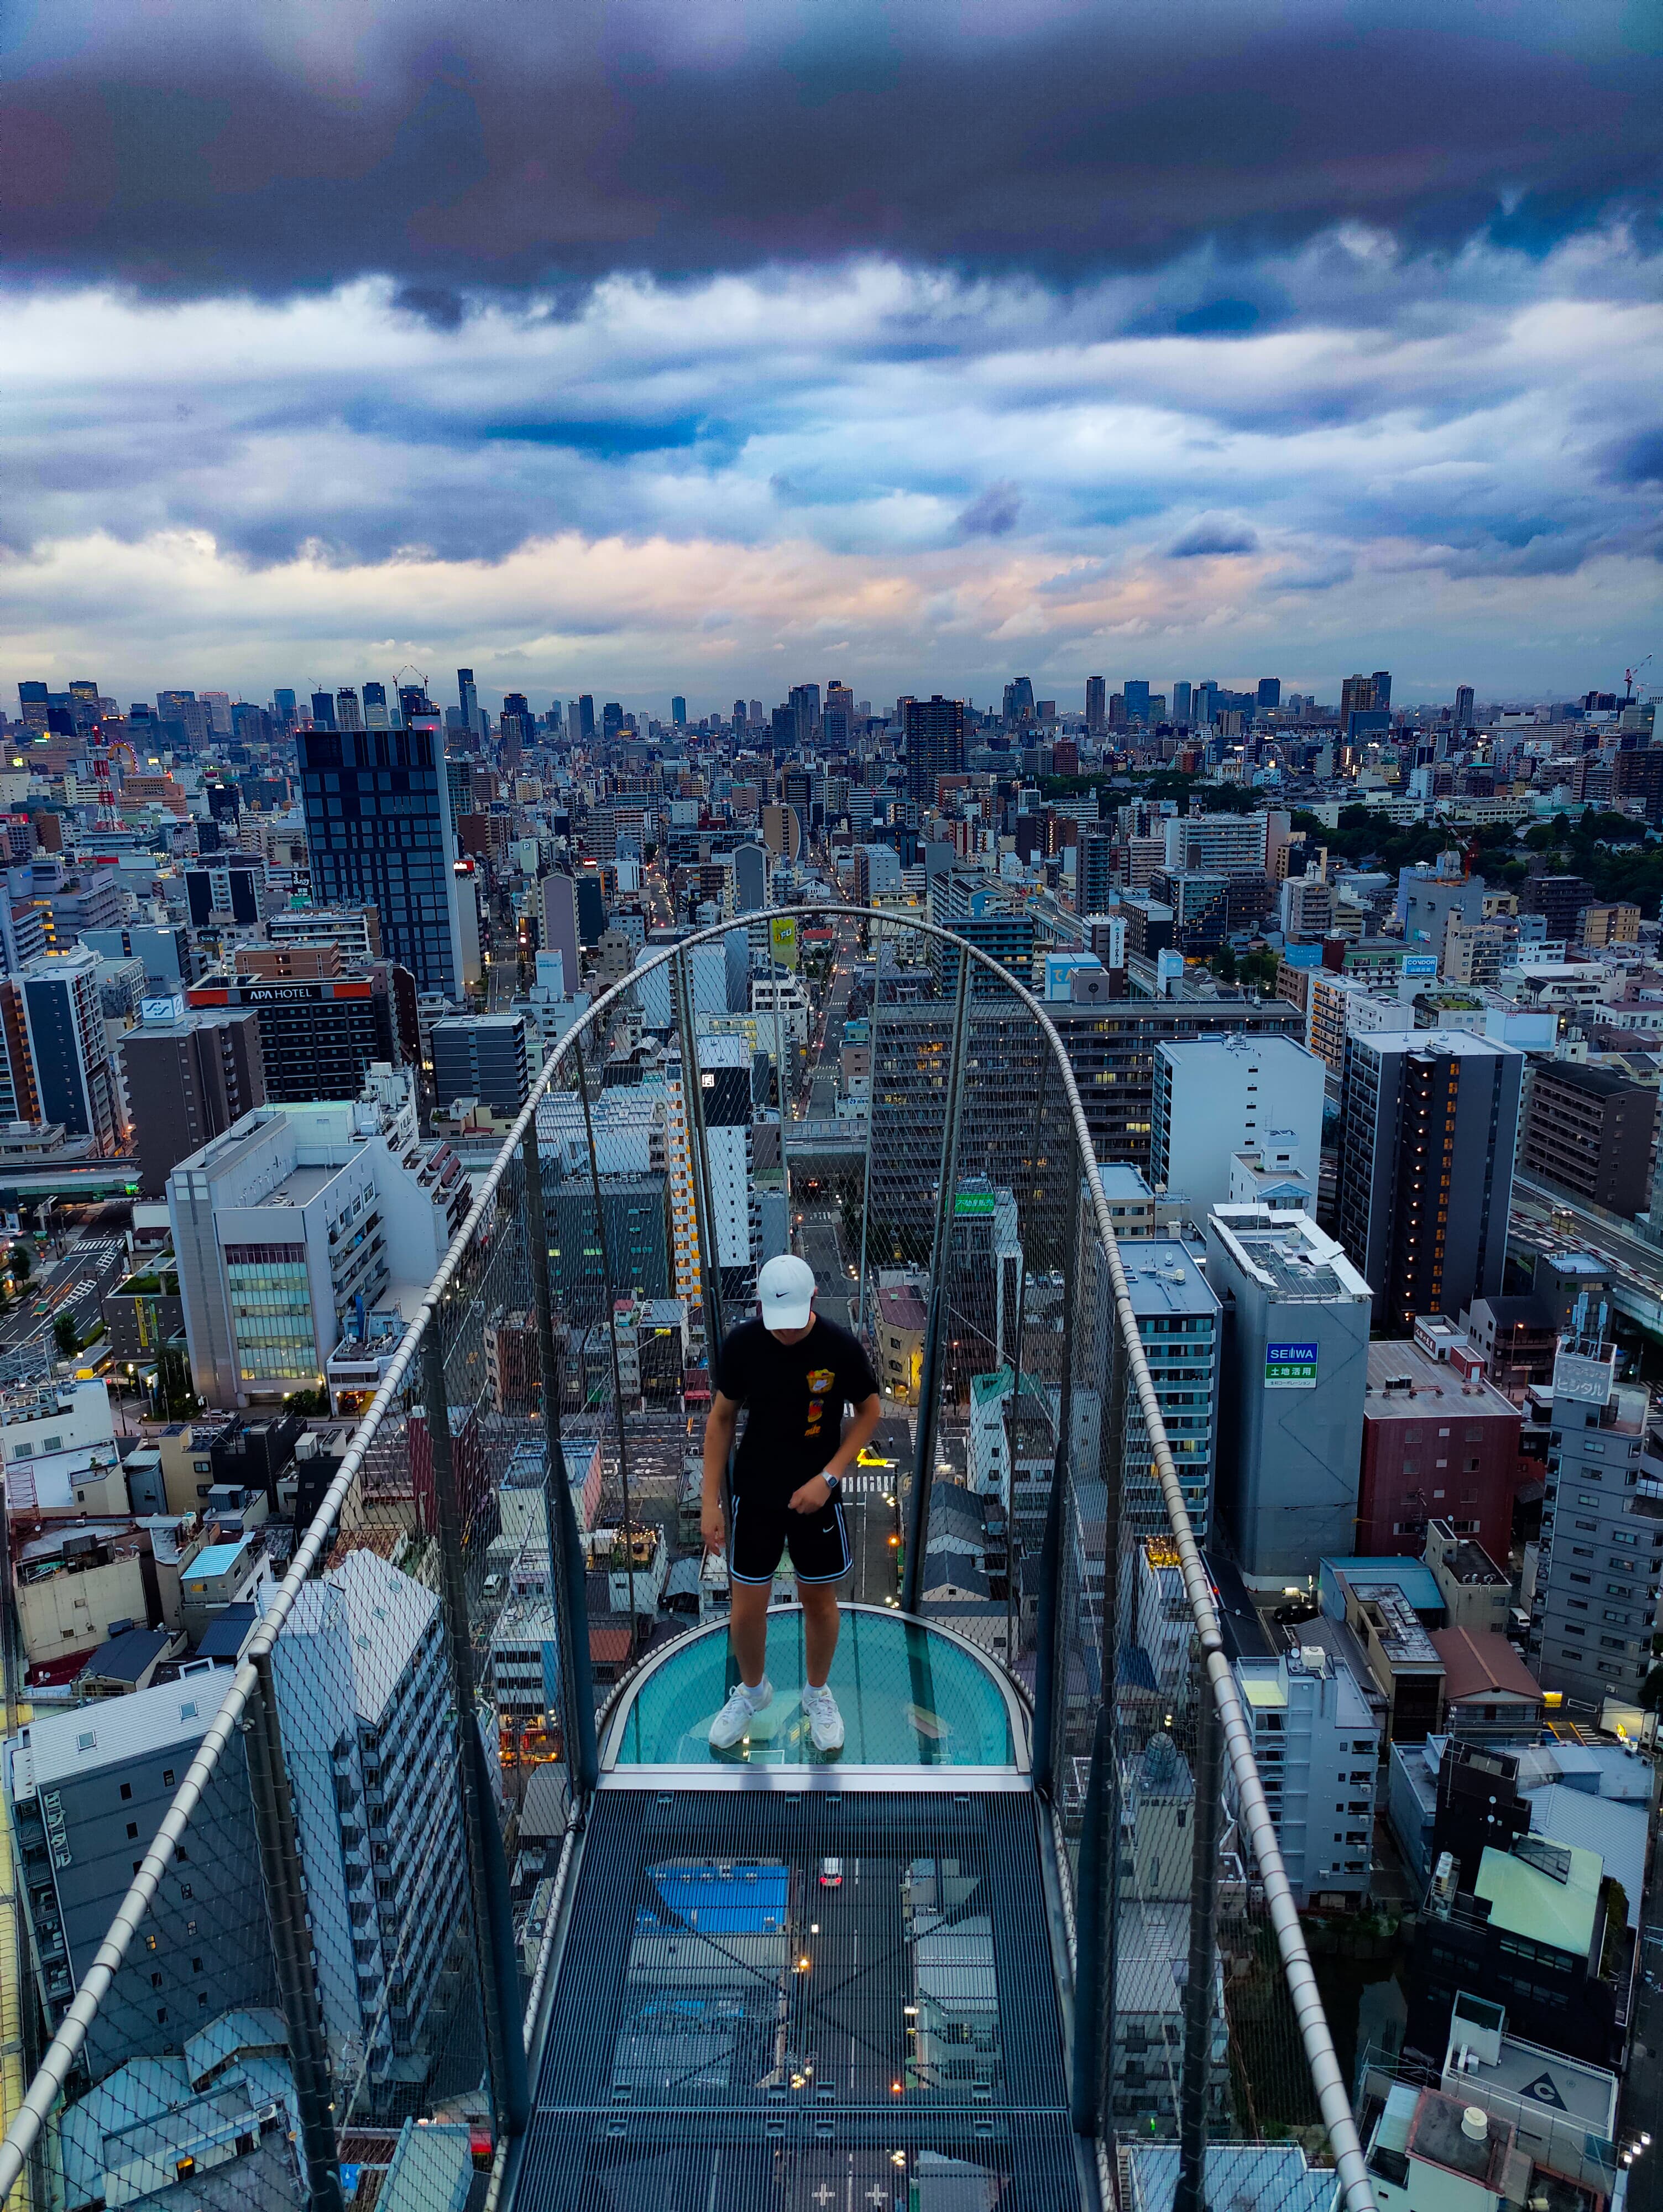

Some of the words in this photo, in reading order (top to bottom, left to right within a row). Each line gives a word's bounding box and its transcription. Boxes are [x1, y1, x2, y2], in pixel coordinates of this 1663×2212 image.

[775, 928, 792, 942] UFO
[250, 990, 273, 1000] APA
[275, 988, 312, 999] HOTEL
[655, 1102, 665, 1114] P
[1270, 1346, 1314, 1358] SEIWA
[1270, 1367, 1311, 1376] 土地活用
